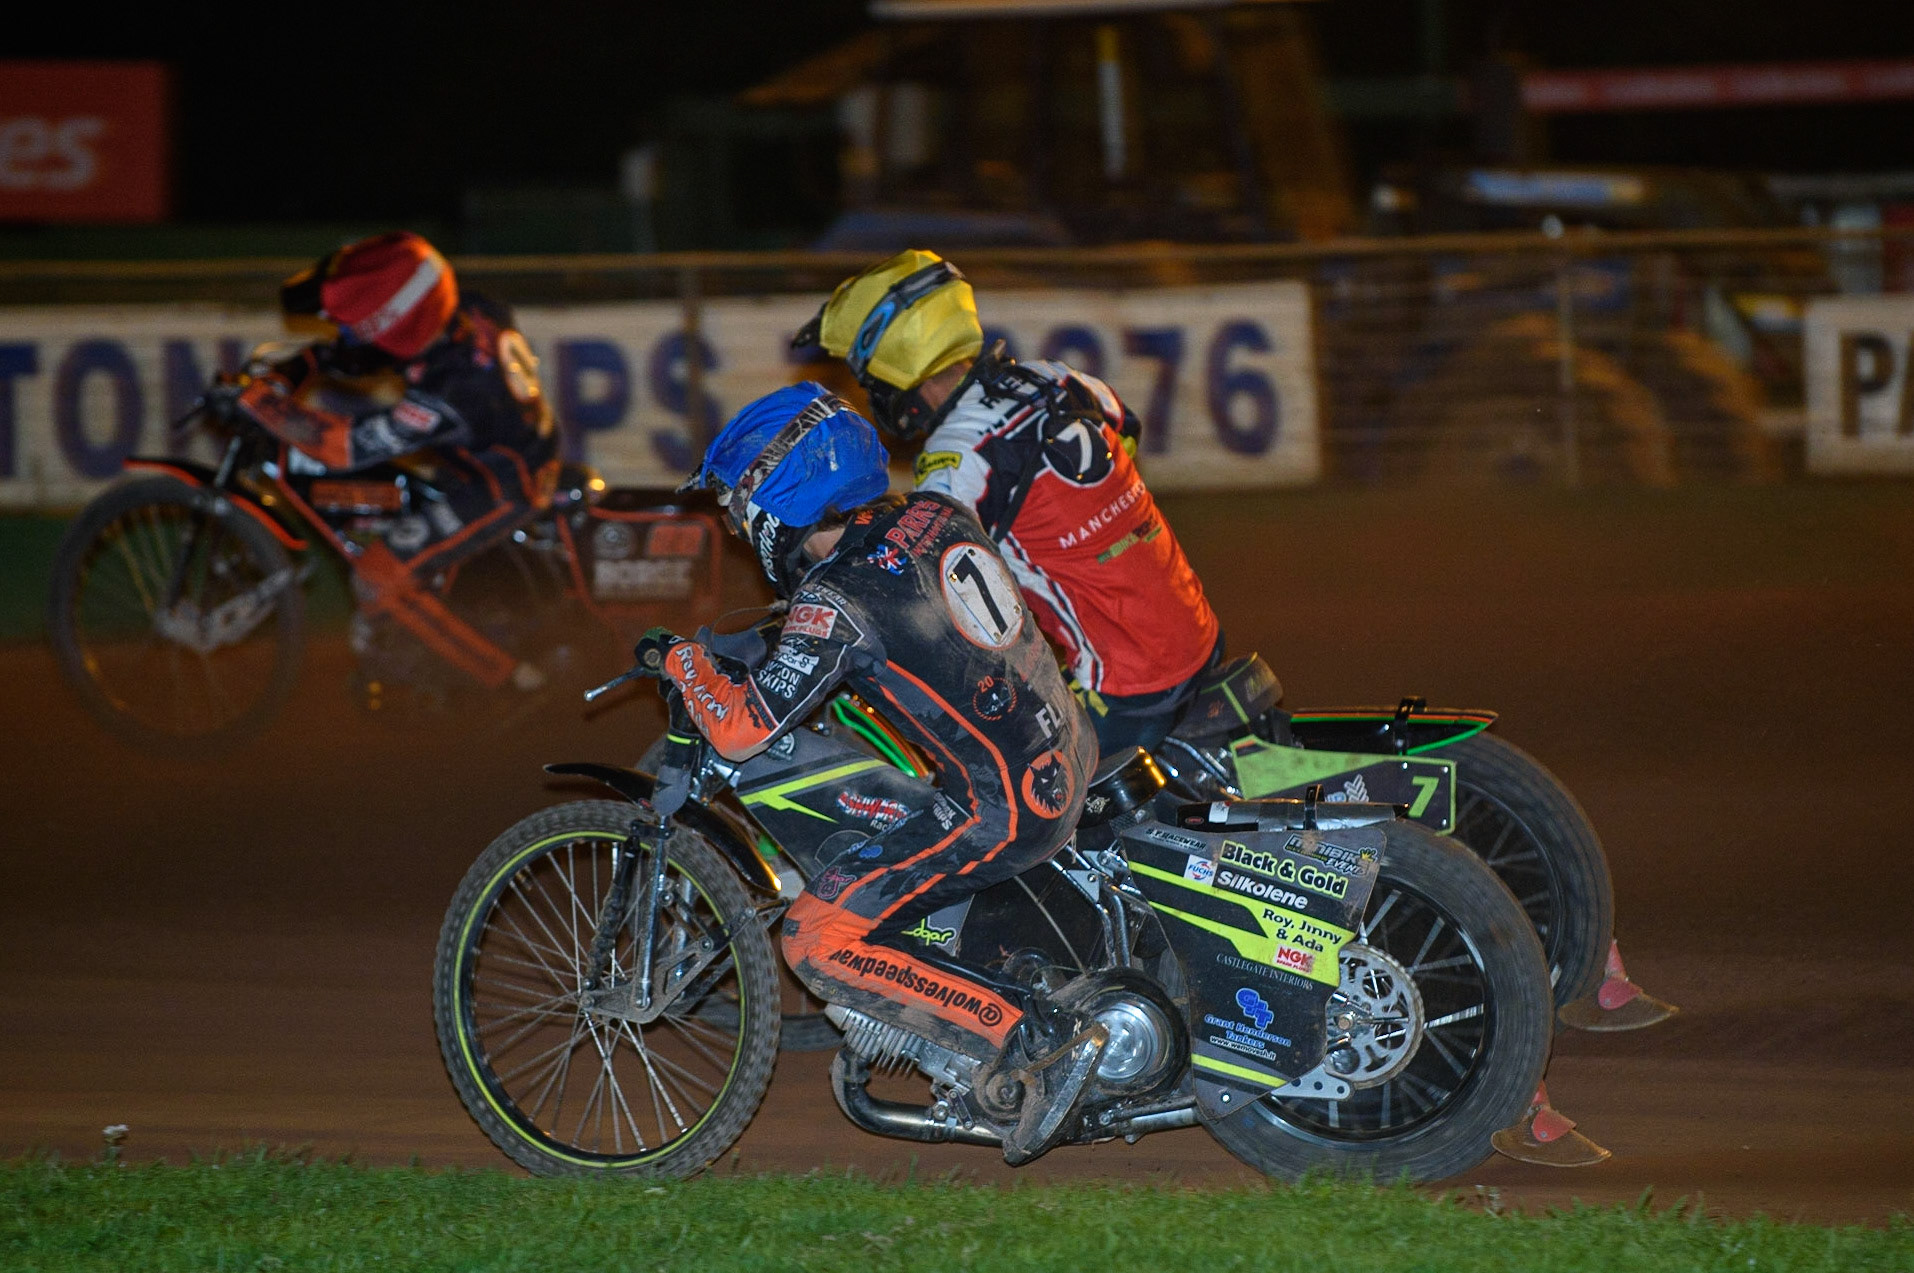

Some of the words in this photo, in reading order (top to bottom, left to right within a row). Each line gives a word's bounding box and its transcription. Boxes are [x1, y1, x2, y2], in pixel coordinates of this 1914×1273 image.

[1056, 421, 1093, 474] 7
[757, 669, 796, 699] SKIPS
[1406, 775, 1440, 818] 7
[1188, 862, 1214, 878] FUCHS
[1220, 840, 1277, 876] Black
[1278, 859, 1297, 883] &
[1298, 865, 1349, 899] Gold
[1217, 870, 1309, 909] Silkolene
[1262, 908, 1295, 930] Roy,
[1298, 919, 1342, 945] Jinny
[1276, 928, 1288, 940] &
[1292, 933, 1324, 952] Ada
[1216, 952, 1267, 977] CASTLEGATE
[1269, 968, 1314, 991] INTERIORS
[1277, 946, 1314, 967] NGK
[1204, 1013, 1235, 1030] Grant
[1235, 1022, 1292, 1047] Henderson
[1226, 1030, 1265, 1049] Tankers
